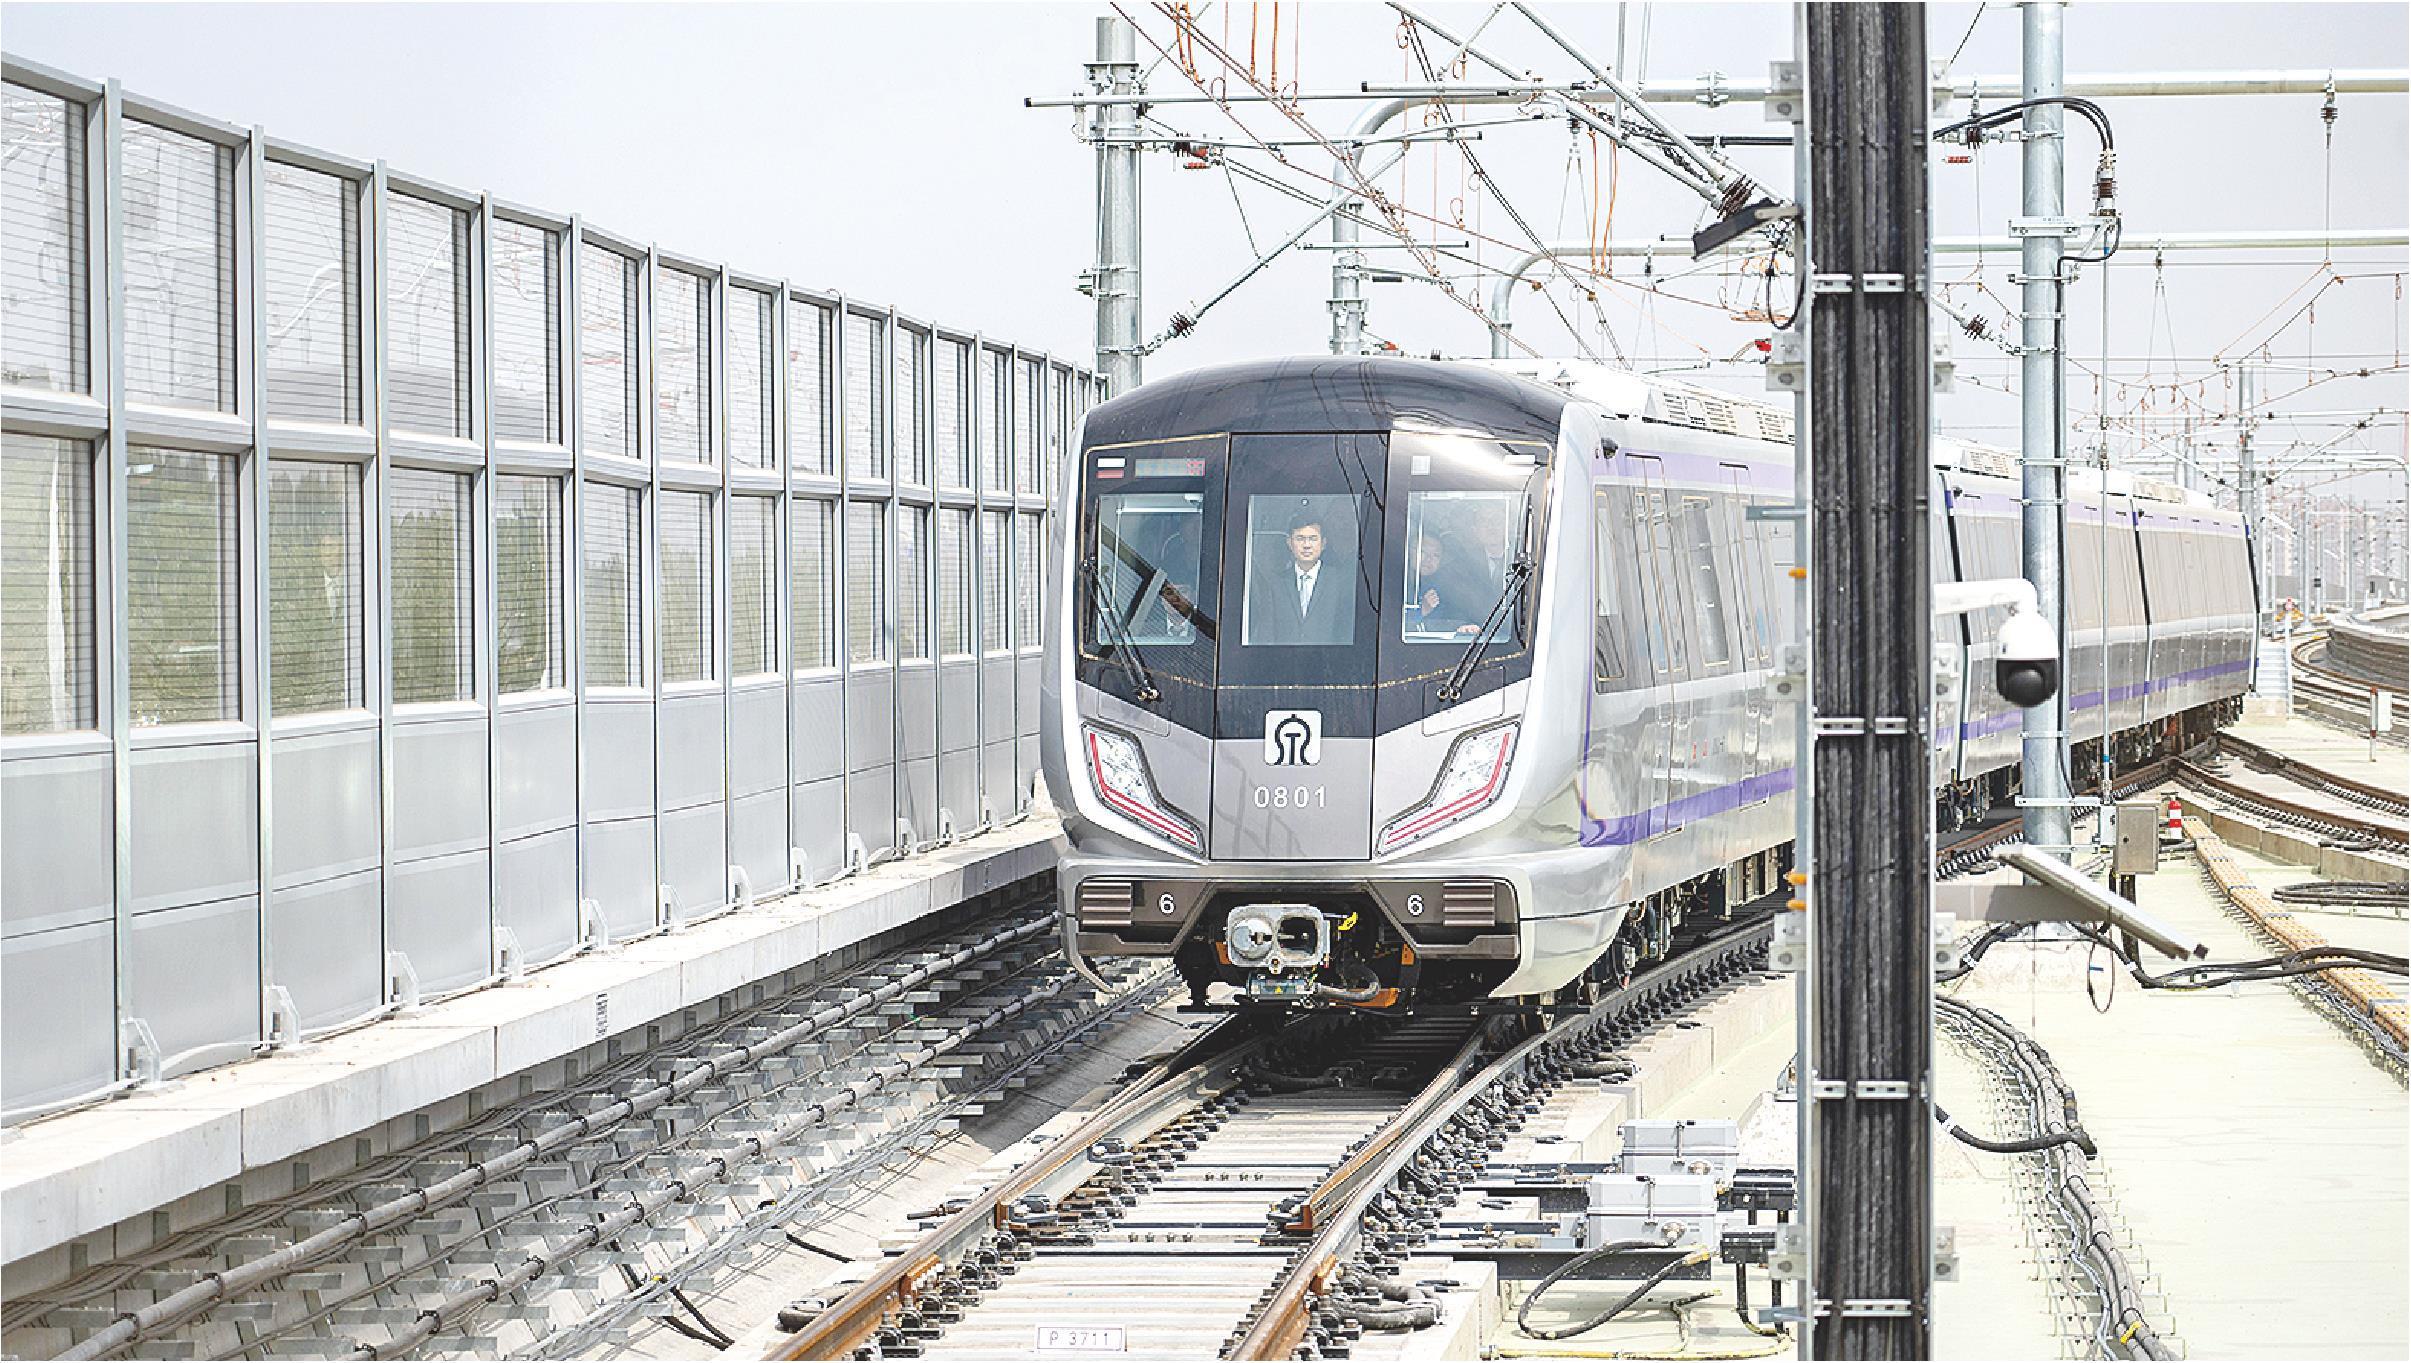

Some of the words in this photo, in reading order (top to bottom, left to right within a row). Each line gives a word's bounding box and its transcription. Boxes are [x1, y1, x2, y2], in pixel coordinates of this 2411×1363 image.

[1254, 785, 1326, 808] 0801
[1159, 893, 1175, 914] 6
[1407, 894, 1423, 916] 6
[1049, 1330, 1059, 1346] P
[1068, 1331, 1108, 1346] 3711
